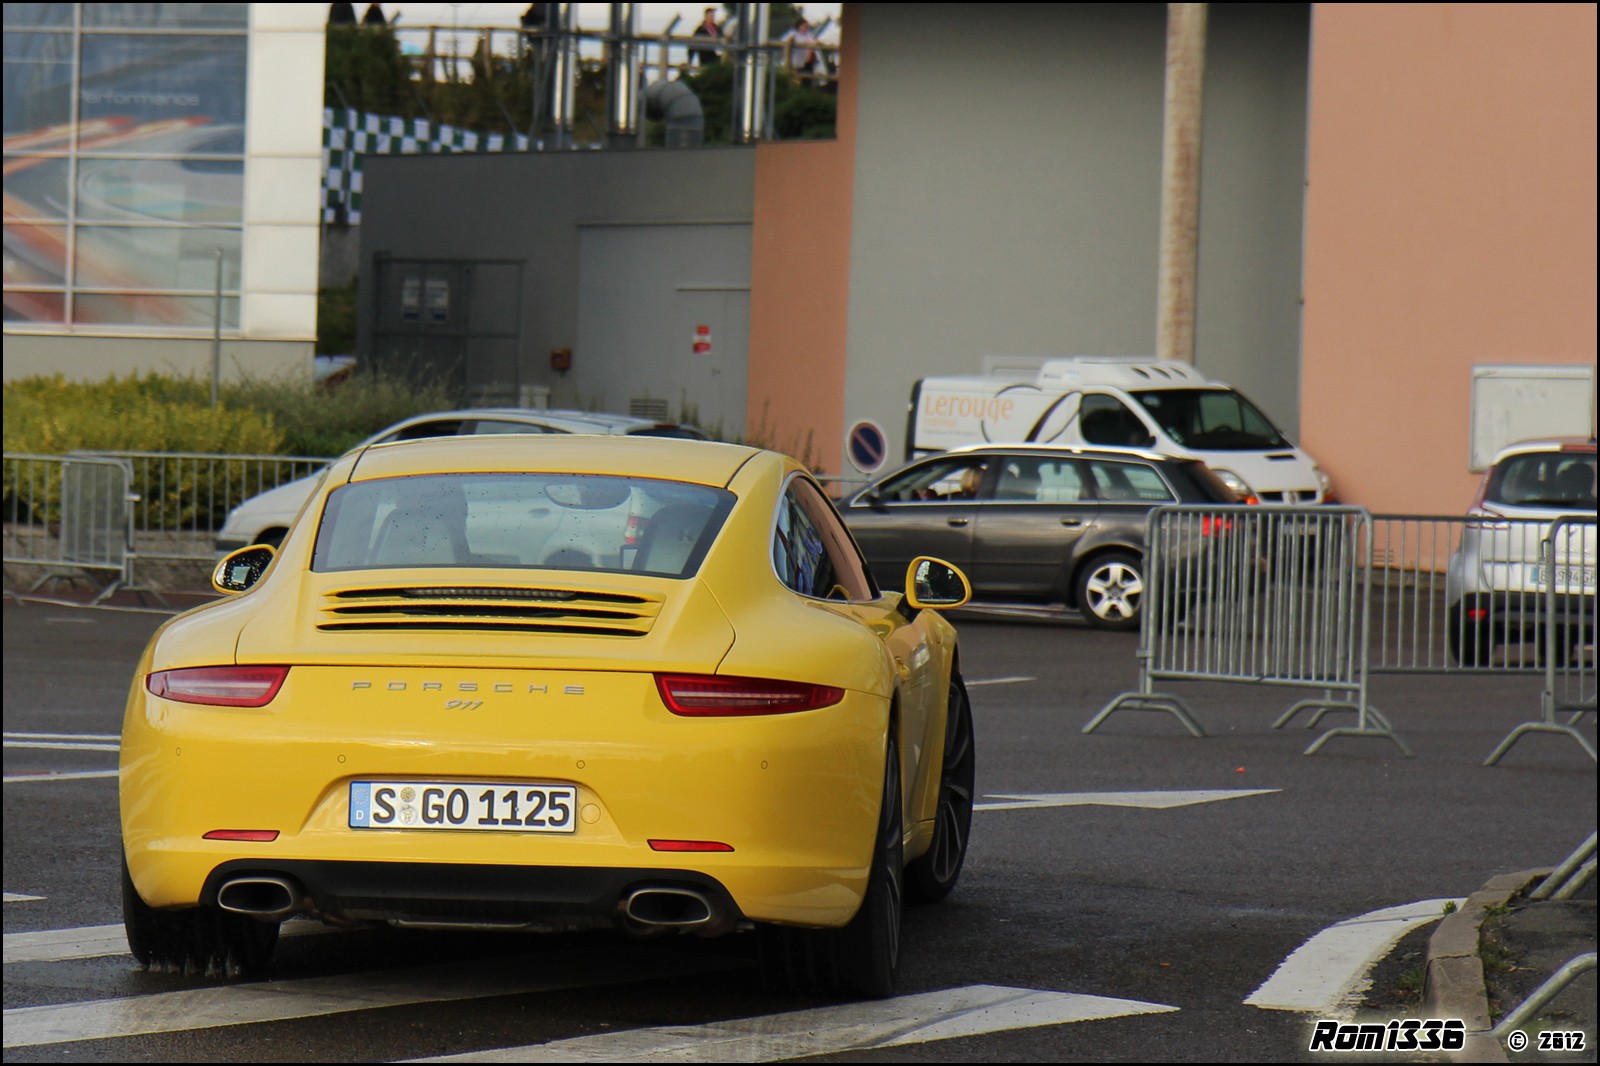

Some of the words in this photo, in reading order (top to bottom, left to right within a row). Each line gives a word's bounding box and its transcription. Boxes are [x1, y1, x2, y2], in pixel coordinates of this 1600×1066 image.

[925, 395, 1014, 424] Lerouge
[352, 681, 585, 695] PORSCHE
[445, 699, 483, 711] 911
[372, 788, 396, 824] S
[422, 788, 470, 825] GO
[477, 789, 571, 827] 1125
[356, 811, 364, 820] D
